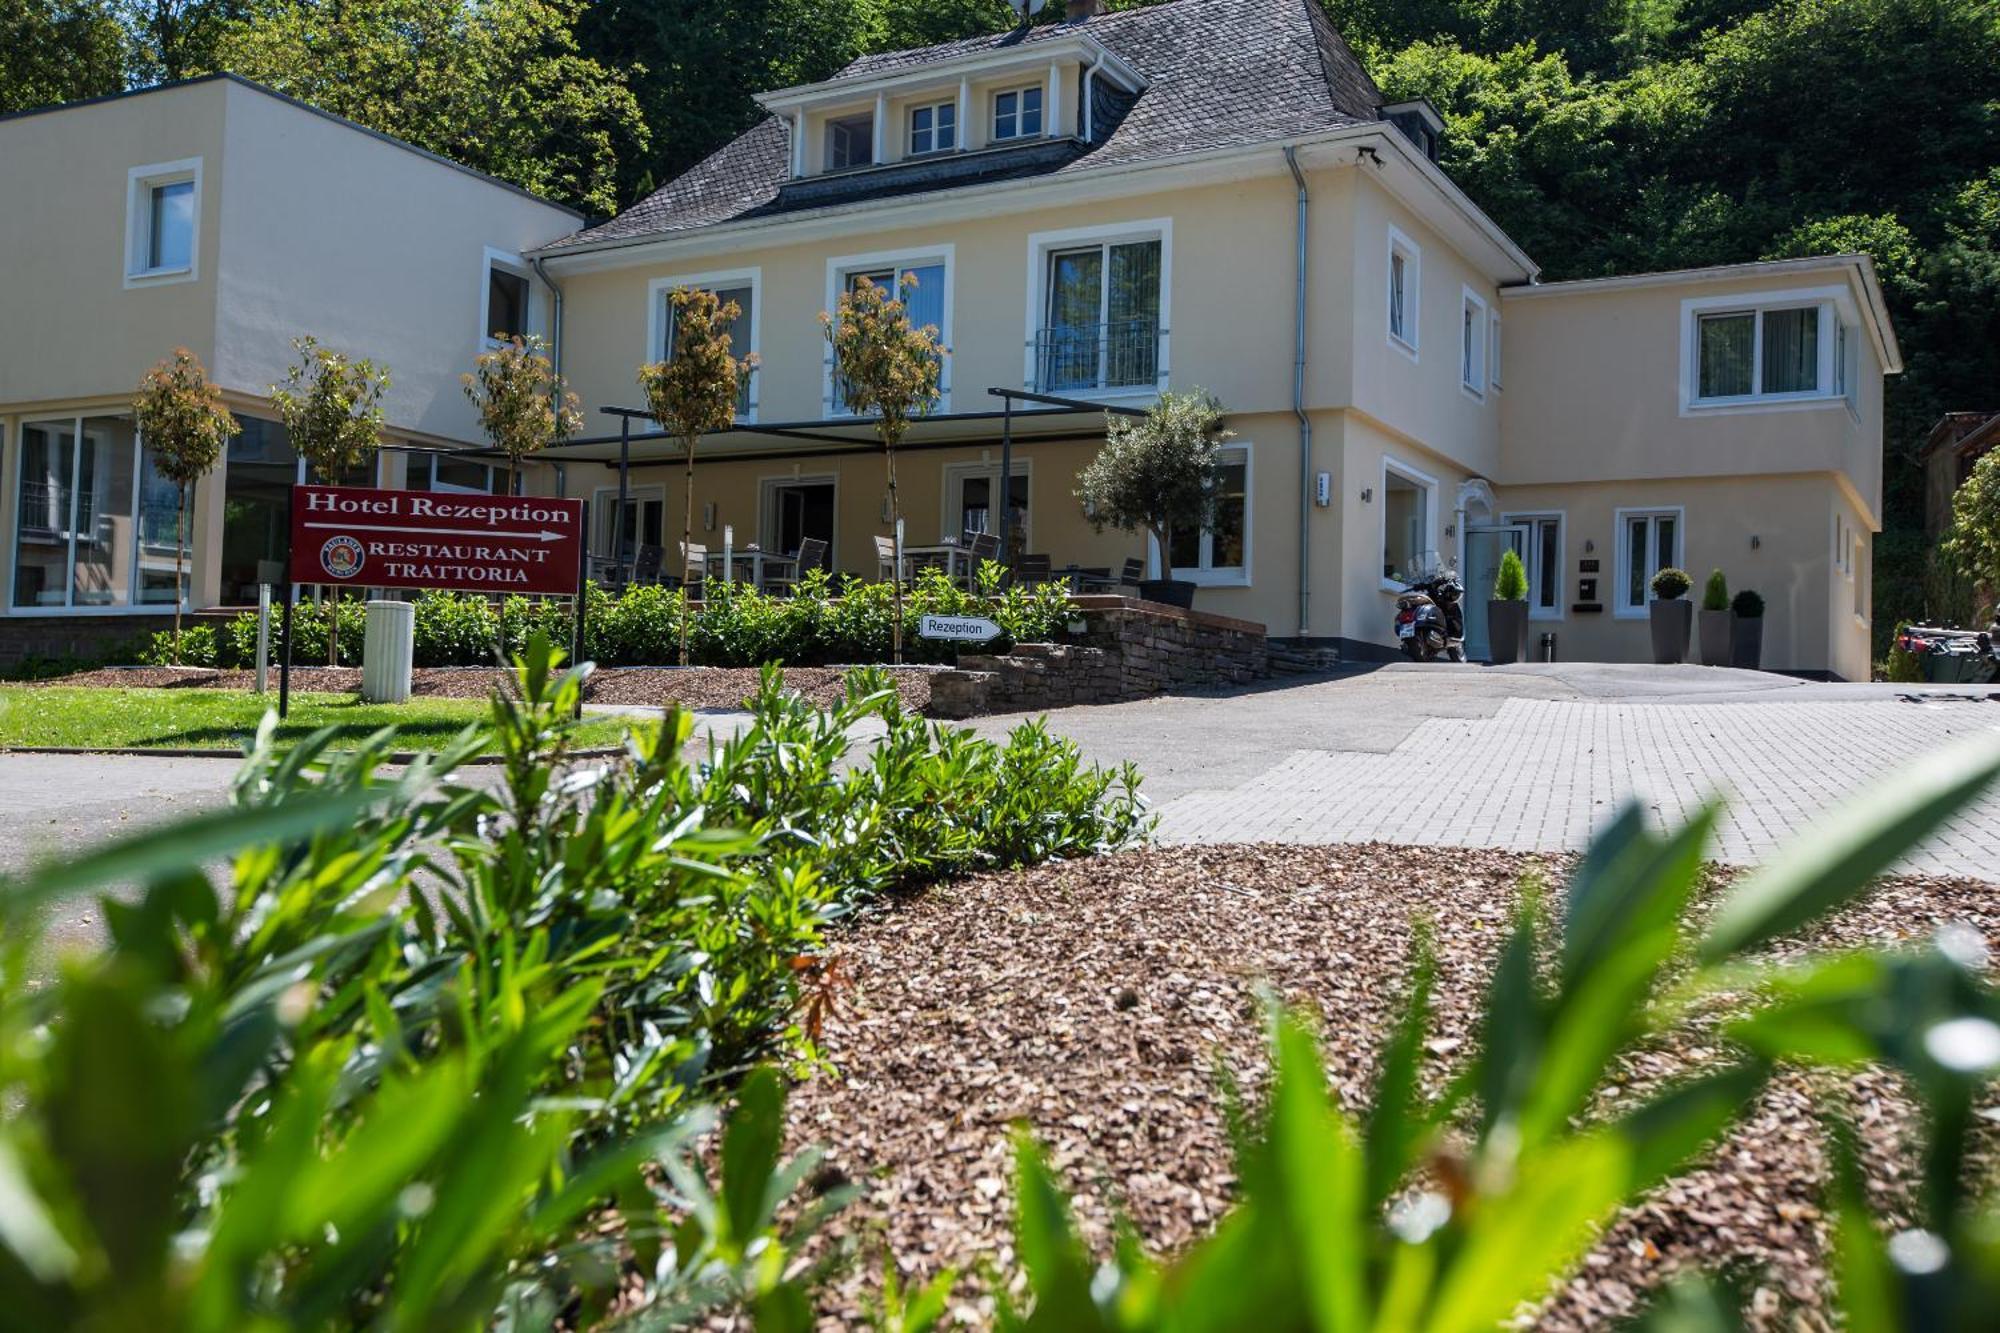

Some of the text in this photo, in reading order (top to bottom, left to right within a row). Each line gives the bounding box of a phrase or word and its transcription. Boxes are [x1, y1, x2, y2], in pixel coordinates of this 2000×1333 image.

[306, 493, 570, 525] Hotel Rezeption
[368, 542, 550, 562] RESTAURANT
[384, 563, 529, 582] TRATTORIA
[928, 620, 982, 635] Rezeption
